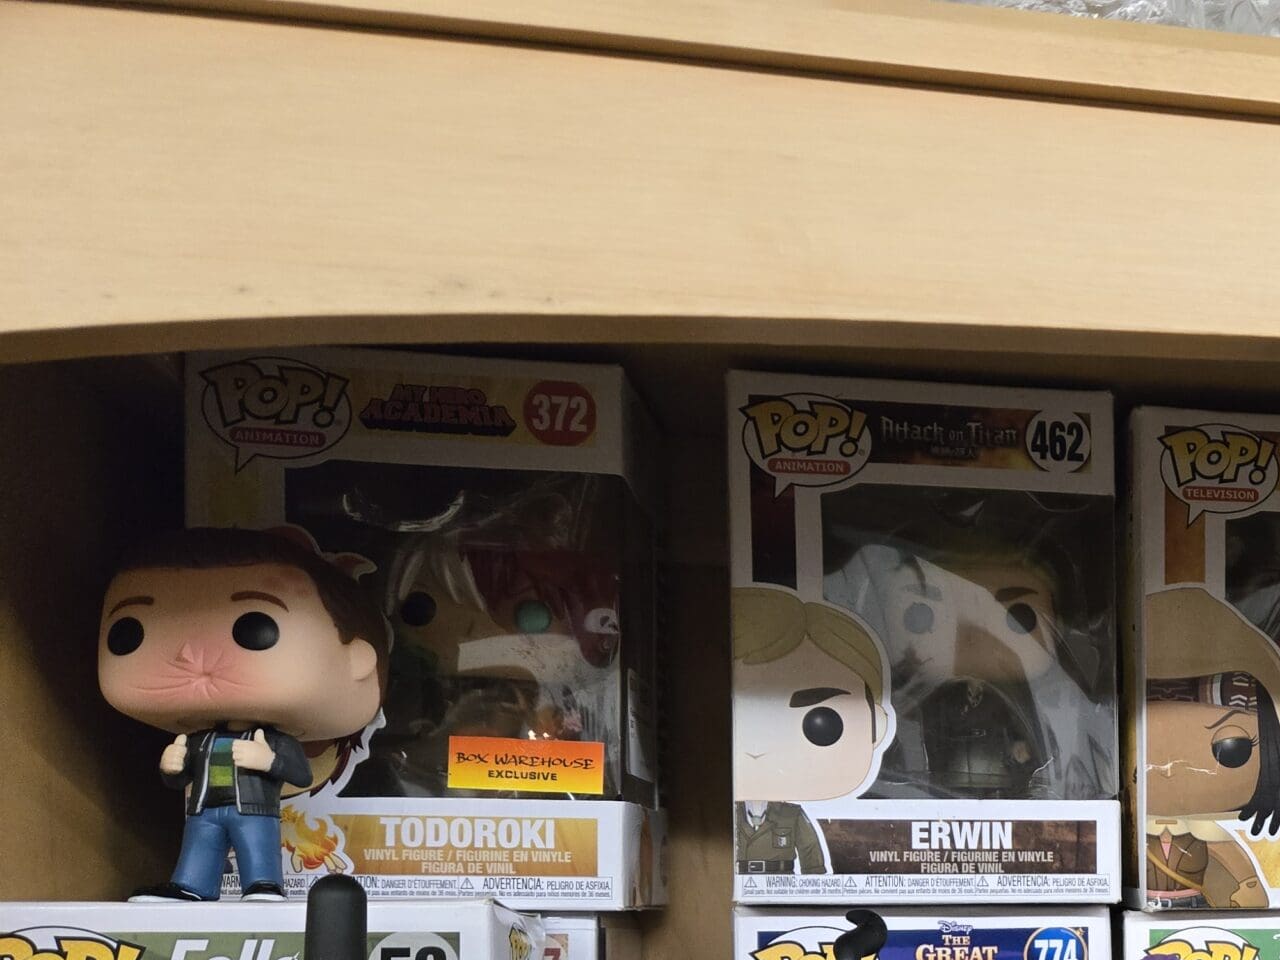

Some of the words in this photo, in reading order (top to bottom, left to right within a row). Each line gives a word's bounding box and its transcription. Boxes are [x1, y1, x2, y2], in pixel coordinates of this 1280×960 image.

[199, 361, 350, 428] POP!
[360, 398, 517, 437] ACADEMIA
[532, 394, 588, 432] 372
[234, 430, 320, 445] ANIMATION
[740, 399, 868, 460] POP!
[880, 415, 945, 445] Attack
[949, 430, 965, 446] on
[966, 420, 1018, 448] Titan
[1030, 420, 1085, 463] 462
[1157, 427, 1277, 488] POP!
[774, 460, 846, 475] ANIMATION
[1185, 488, 1257, 502] TELEVISION
[454, 751, 489, 765] BOX
[494, 752, 598, 771] WAREHOUSE
[487, 768, 559, 783] EXCLUSIVE
[379, 816, 556, 850] TODOROKI
[910, 820, 1013, 850] ERWIN
[363, 849, 399, 862] VINYL
[402, 849, 444, 863] FIGURE
[456, 850, 509, 864] FIGURINE
[513, 851, 528, 864] EN
[531, 851, 572, 865] VINYLE
[869, 850, 900, 863] VINYL
[902, 850, 941, 863] FIGURE
[951, 851, 998, 863] FIGURINE
[1001, 851, 1015, 863] EN
[1017, 851, 1054, 863] VINYLE
[421, 861, 462, 875] FIGURA
[466, 861, 485, 875] DE
[487, 862, 517, 876] VINIL
[920, 862, 959, 874] FIGURA
[962, 863, 976, 874] DE
[977, 863, 1005, 874] VINIL
[482, 877, 545, 890] ADVERTENCIA:
[547, 880, 575, 891] PELIGRO
[865, 875, 906, 888] ATTENTION:
[997, 876, 1050, 888] ADVERTENCIA:
[938, 919, 974, 937] Disney
[941, 935, 971, 950] THE
